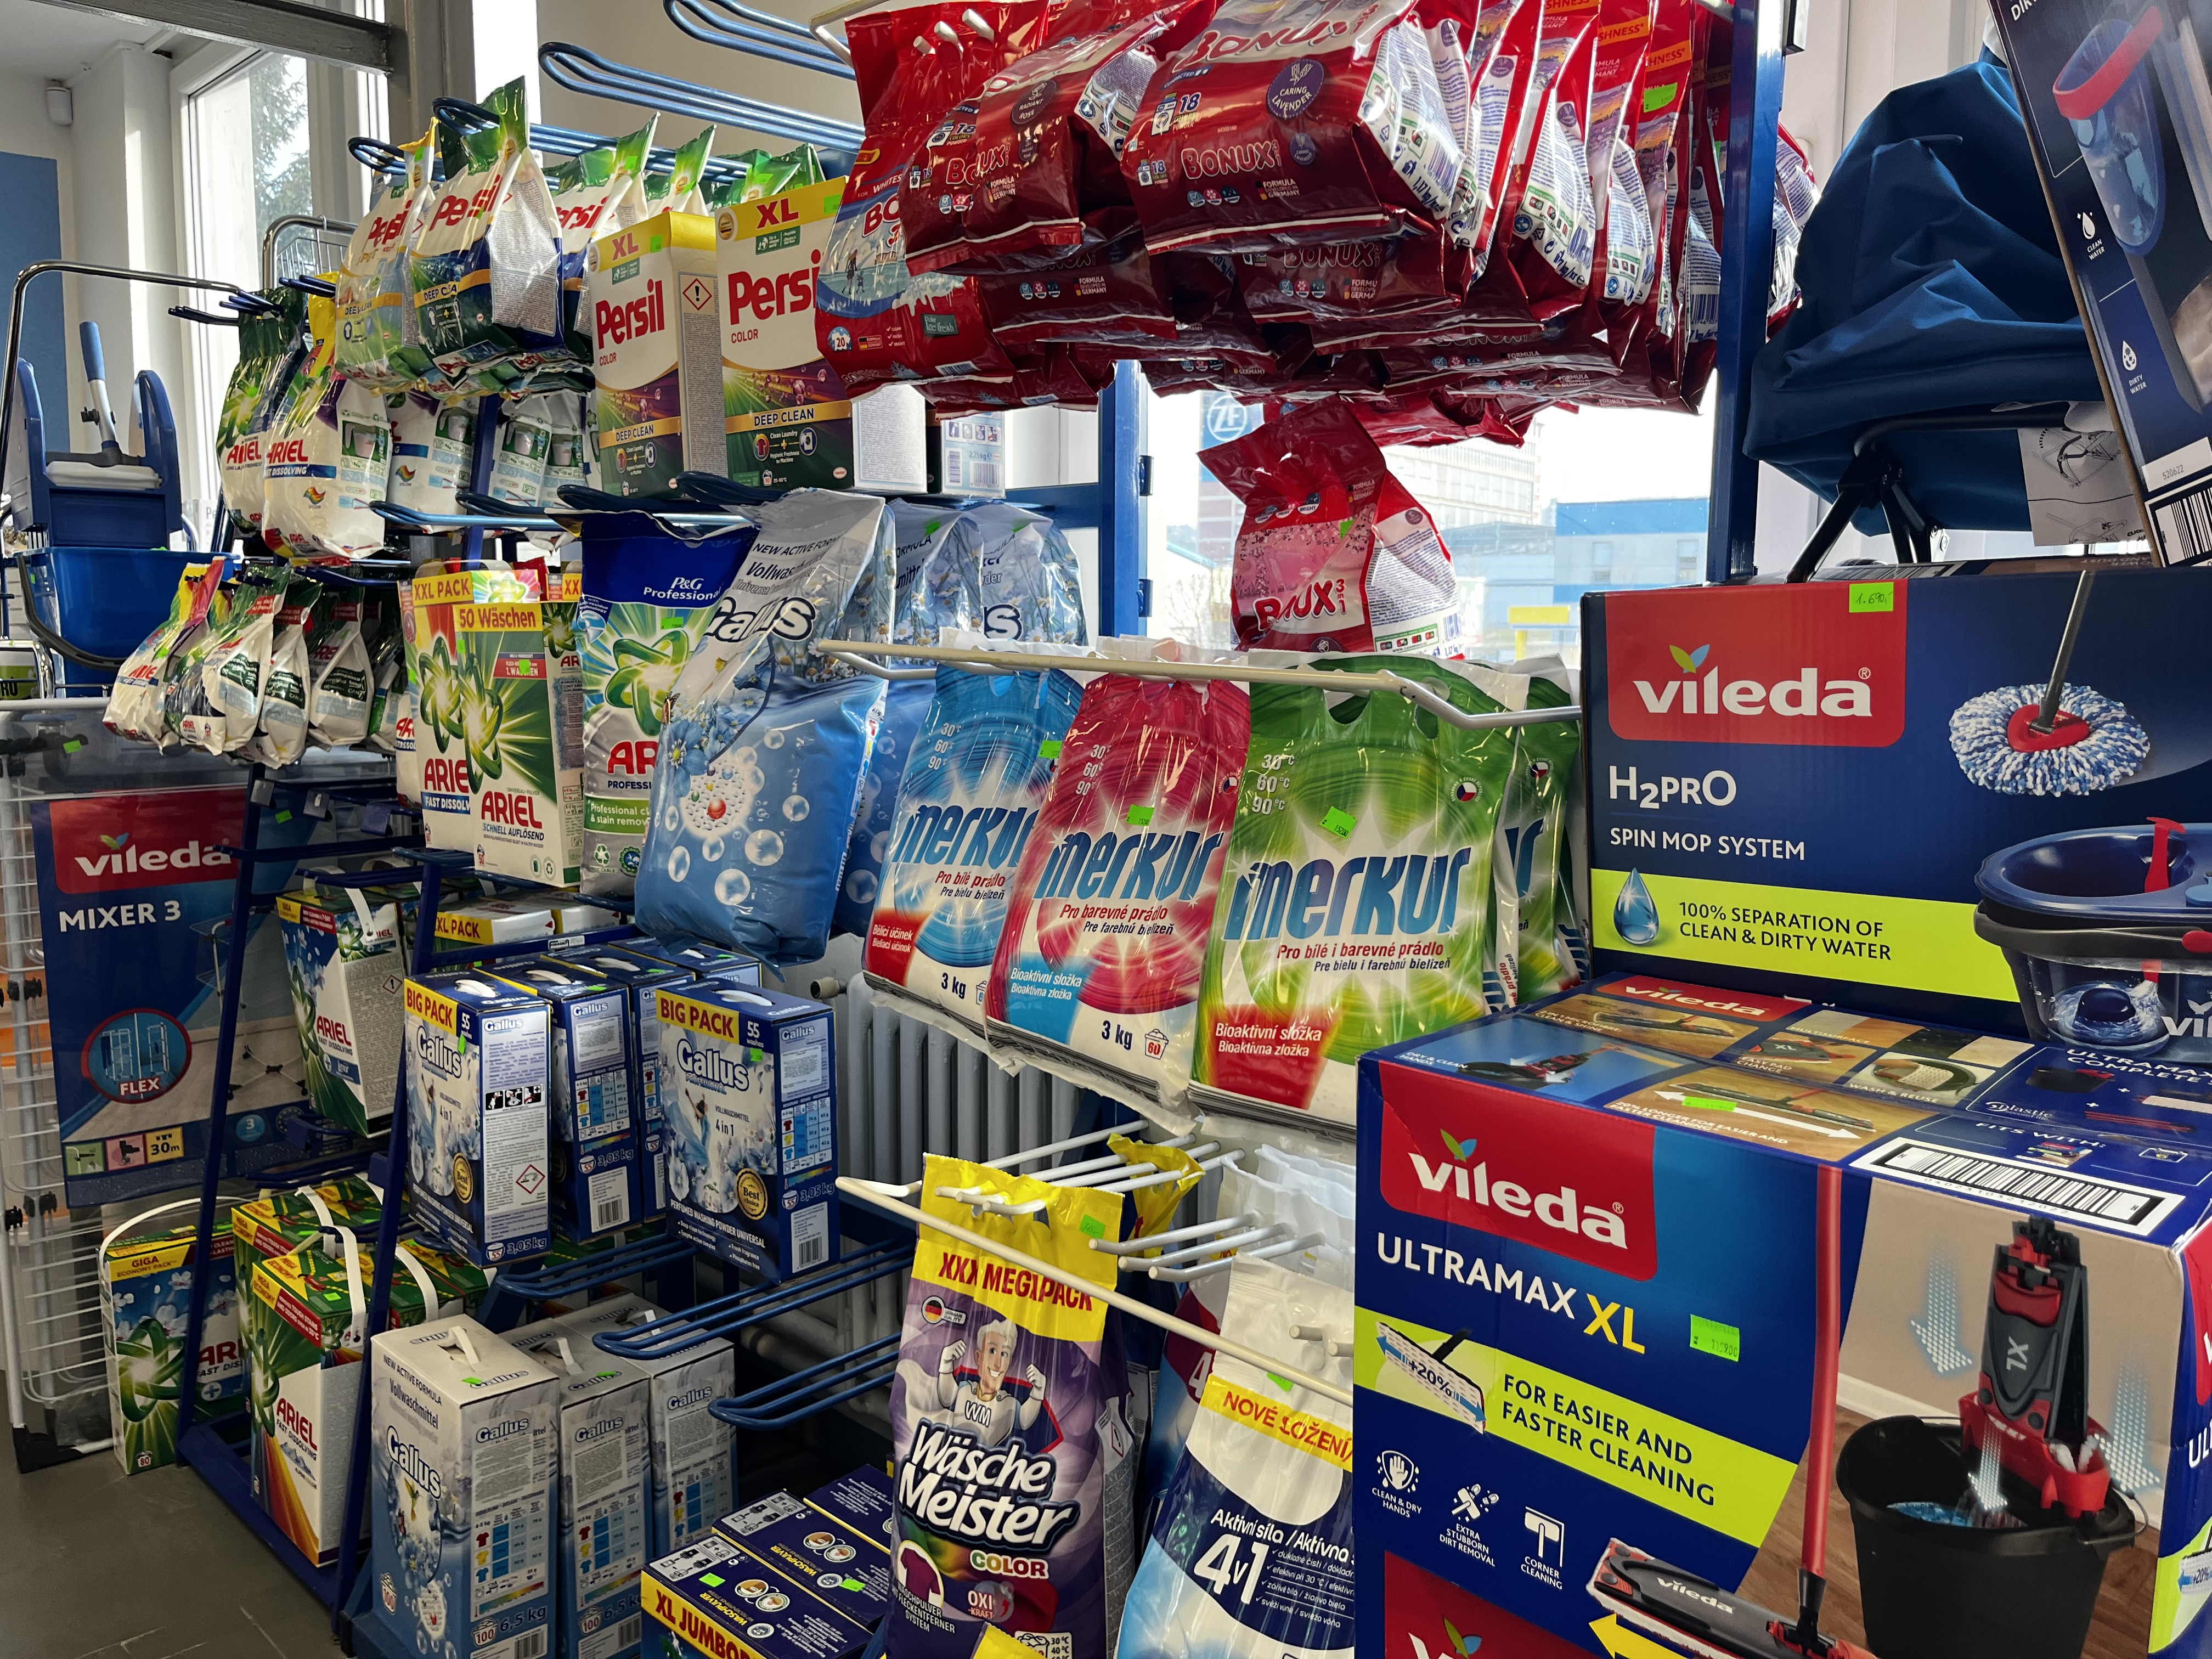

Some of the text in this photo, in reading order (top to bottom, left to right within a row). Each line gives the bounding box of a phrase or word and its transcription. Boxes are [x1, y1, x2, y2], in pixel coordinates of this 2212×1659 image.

[1018, 98, 1044, 111] RADIANT
[1179, 93, 1201, 113] 18
[1272, 91, 1313, 112] LAVENDER
[1279, 86, 1307, 97] CARING
[1018, 109, 1036, 120] ROSE
[1181, 140, 1276, 180] BONUX
[873, 173, 902, 194] WHITES
[1263, 178, 1296, 188] FORMULA
[1268, 189, 1300, 198] GERMANY
[756, 198, 799, 228] XL
[611, 232, 639, 261] XL
[2087, 239, 2102, 253] CLEAN
[2089, 246, 2105, 261] WATER
[595, 278, 665, 350] Persil
[731, 329, 759, 344] COLOR
[836, 337, 846, 348] 20
[599, 352, 617, 366] COLOR
[2129, 374, 2143, 387] DIRTY
[2130, 381, 2147, 394] WATER
[754, 408, 815, 427] DEEP CLEAN
[616, 424, 654, 442] DEEP CLEAN
[2162, 464, 2185, 480] 520622
[414, 578, 471, 601] XXL PACK
[643, 586, 721, 601] Professional
[670, 577, 704, 590] P&G
[460, 606, 537, 629] 50 Wäschen
[1632, 665, 1873, 718] vileda
[481, 790, 543, 830] ARIEL
[590, 803, 638, 816] Professional
[482, 822, 545, 842] SCHNELL AUFLÖSEND
[1609, 827, 1805, 861] SPIN MOP SYSTEM
[75, 841, 232, 877] vileda
[1032, 830, 1226, 902] merkur
[1221, 847, 1472, 941] merkur
[59, 900, 182, 933] MIXER 3
[1059, 904, 1168, 923] Pro barevné prádlo
[1679, 901, 1883, 936] 100% SEPARATION OF
[1083, 921, 1099, 934] Pre
[1101, 921, 1136, 936] farebnú
[1679, 922, 1892, 961] CLEAN & DIRTY WATER
[1277, 941, 1444, 960] Pro bílé i barevné prádlo
[941, 973, 967, 1000] 3 kg
[1010, 967, 1082, 988] Bioaktivní složka
[407, 988, 453, 1029] BIG PACK
[572, 1001, 608, 1017] Gallus
[1626, 986, 1769, 1016] vileda
[316, 1015, 352, 1047] ARIEL
[461, 1012, 471, 1031] 55
[484, 1018, 524, 1032] Gallus
[660, 997, 735, 1039] BIG PACK
[747, 1020, 760, 1037] 55
[781, 1025, 815, 1041] Gallus
[1102, 1019, 1133, 1051] 3 kg
[1215, 1023, 1322, 1042] Bioaktivní složka
[1789, 1026, 1871, 1045] MULTISURFACE
[328, 1040, 353, 1056] DISSOLVING
[416, 1025, 462, 1078] Gallus
[1148, 1041, 1161, 1057] 60
[1273, 1041, 1310, 1056] zložka
[676, 1038, 750, 1092] Gallus
[2067, 1057, 2200, 1084] COMPLETE
[119, 1077, 160, 1096] FLEX
[1976, 1121, 2107, 1149] FITS WITH:
[743, 1186, 760, 1201] Best
[1408, 1153, 1628, 1250] vileda
[670, 1198, 693, 1217] PERFUMED
[693, 1207, 715, 1227] WASHING
[714, 1218, 737, 1238] POWDER
[736, 1226, 766, 1249] UNIVERSAL
[132, 1255, 160, 1268] GIGA
[938, 1251, 978, 1286] XXX
[1378, 1232, 1646, 1355] ULTRAMAX XL
[383, 1355, 442, 1407] NEW ACTIVE FORMULA
[1408, 1356, 1454, 1398] +20%
[389, 1378, 439, 1430] Vollwaschmittel
[667, 1386, 713, 1412] Gallus
[276, 1397, 318, 1452] ARIEL
[964, 1400, 992, 1426] WM
[1504, 1374, 1693, 1466] FOR EASIER AND
[476, 1417, 529, 1444] Gallus
[574, 1415, 623, 1443] Gallus
[139, 1457, 151, 1466] 80
[386, 1425, 441, 1500] Gallus
[911, 1425, 1051, 1493] Wäsche
[1502, 1401, 1716, 1508] FASTER CLEANING
[899, 1462, 1073, 1545] Meister
[1372, 1487, 1423, 1515] CLEAN & DRY
[1382, 1500, 1412, 1519] HANDS
[1210, 1509, 1259, 1536] Aktivní
[1255, 1522, 1284, 1544] síla
[1294, 1531, 1350, 1562] Aktívna
[1446, 1528, 1489, 1554] STUBBORN
[1455, 1523, 1481, 1541] EXTRA
[1439, 1533, 1496, 1568] DIRT REMOVAL
[970, 1551, 1049, 1579] COLOR
[1520, 1563, 1563, 1591] CLEANING
[1525, 1556, 1560, 1579] CORNER
[656, 1589, 676, 1626] XL
[967, 1590, 994, 1611] OXI
[1656, 1577, 1735, 1615] vileda
[499, 1605, 547, 1633] 6,5 kg
[905, 1612, 930, 1633] SYSTEM
